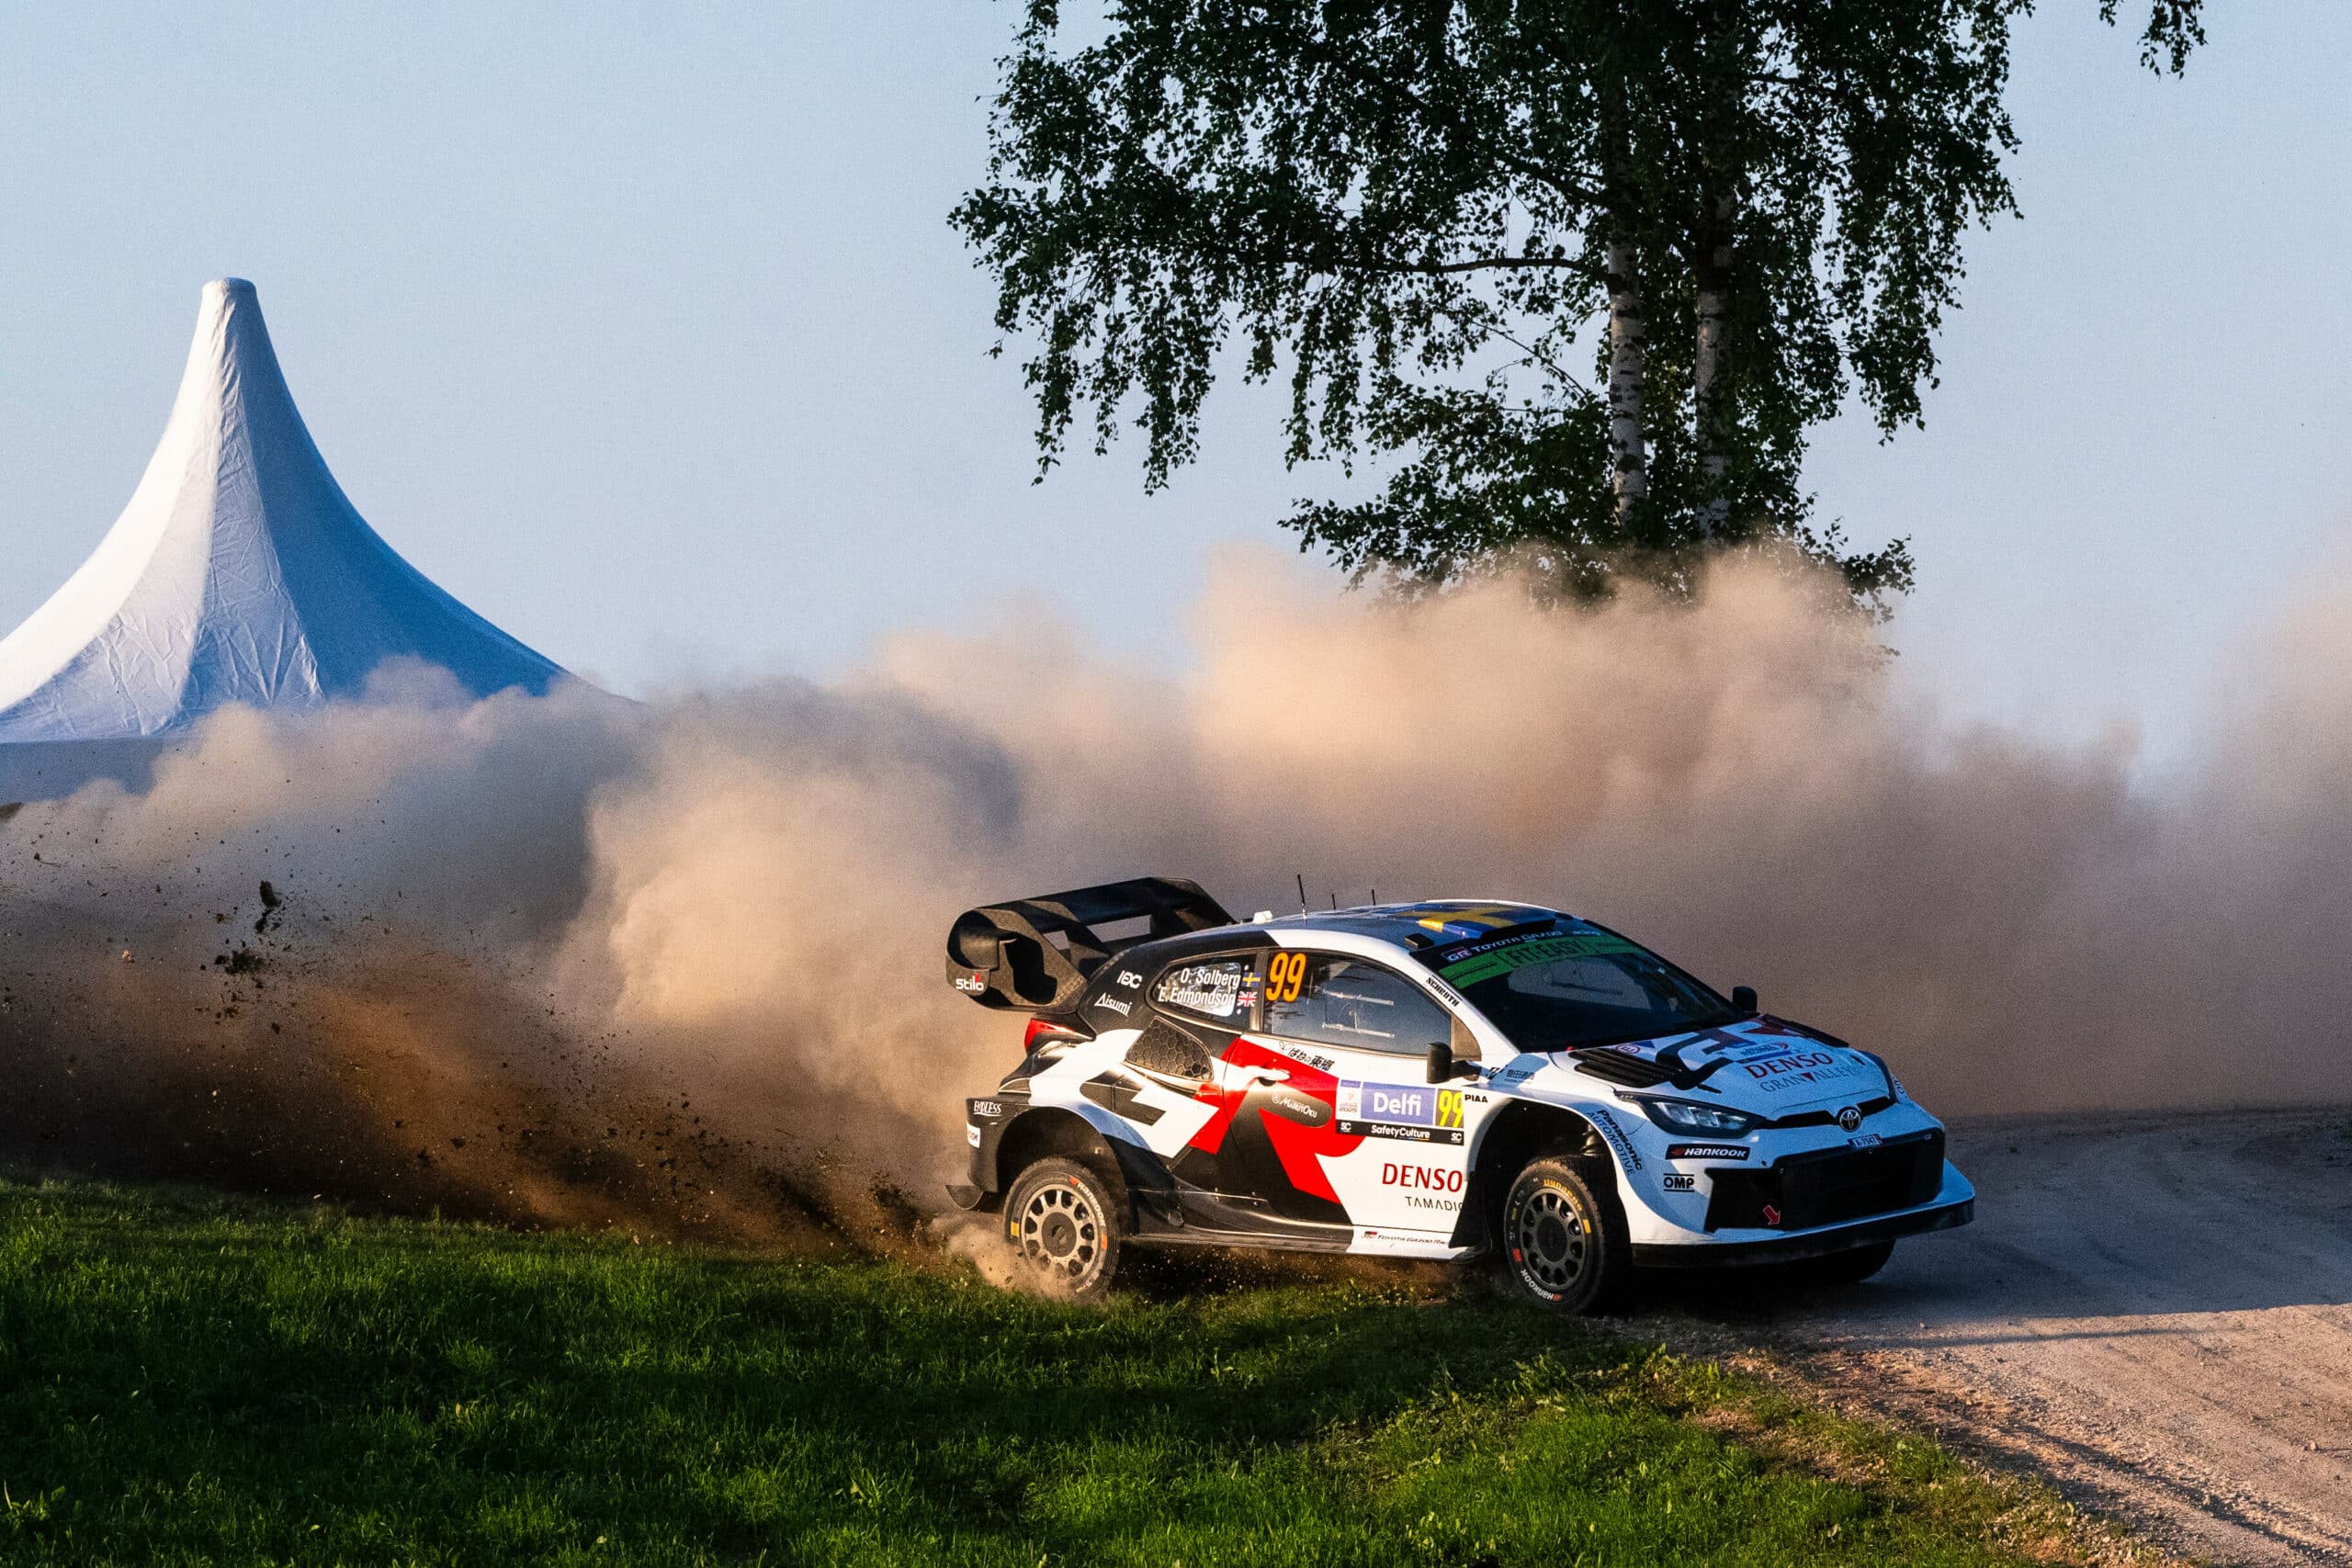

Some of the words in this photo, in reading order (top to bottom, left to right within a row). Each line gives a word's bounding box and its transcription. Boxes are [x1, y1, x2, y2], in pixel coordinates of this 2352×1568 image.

[1471, 937, 1521, 953] TOYOTA
[956, 974, 984, 990] Stilo
[1180, 967, 1192, 984] O.
[1196, 968, 1240, 989] Solberg
[1266, 952, 1306, 1002] 99
[1170, 987, 1236, 1007] Edmondson
[1426, 976, 1460, 1007] SCHROTH
[1744, 1052, 1834, 1078] DENSO
[974, 1100, 1001, 1114] ENDLESS
[1373, 1092, 1422, 1116] Delfi
[1438, 1090, 1464, 1128] 99
[1464, 1094, 1488, 1103] PIAA
[1372, 1124, 1430, 1139] SafetyCulture
[1597, 1109, 1643, 1171] Panasonic
[1587, 1111, 1635, 1176] AUTOMOTIVE
[1381, 1163, 1463, 1192] DENSO
[1663, 1177, 1694, 1190] OMP
